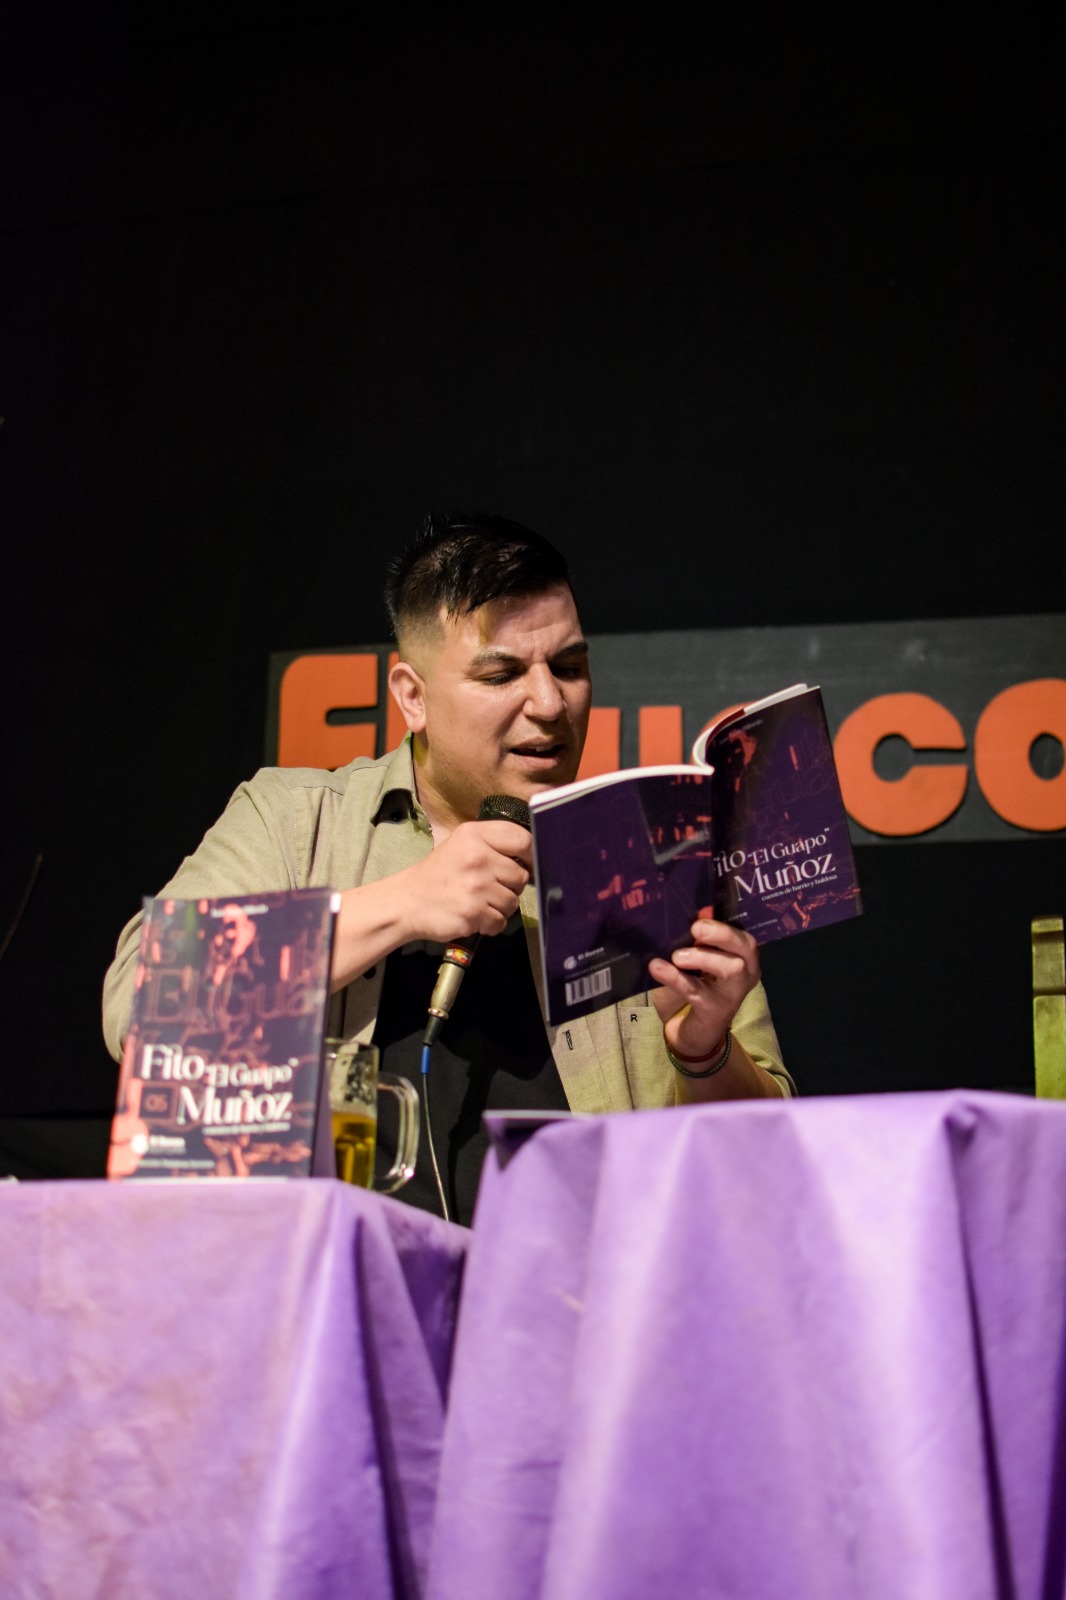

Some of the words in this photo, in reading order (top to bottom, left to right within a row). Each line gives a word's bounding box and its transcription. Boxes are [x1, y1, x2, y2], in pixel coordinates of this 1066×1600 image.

[713, 850, 746, 877] ito
[733, 853, 836, 902] Muñoz
[630, 1013, 638, 1023] R
[176, 1085, 294, 1126] Muñoz
